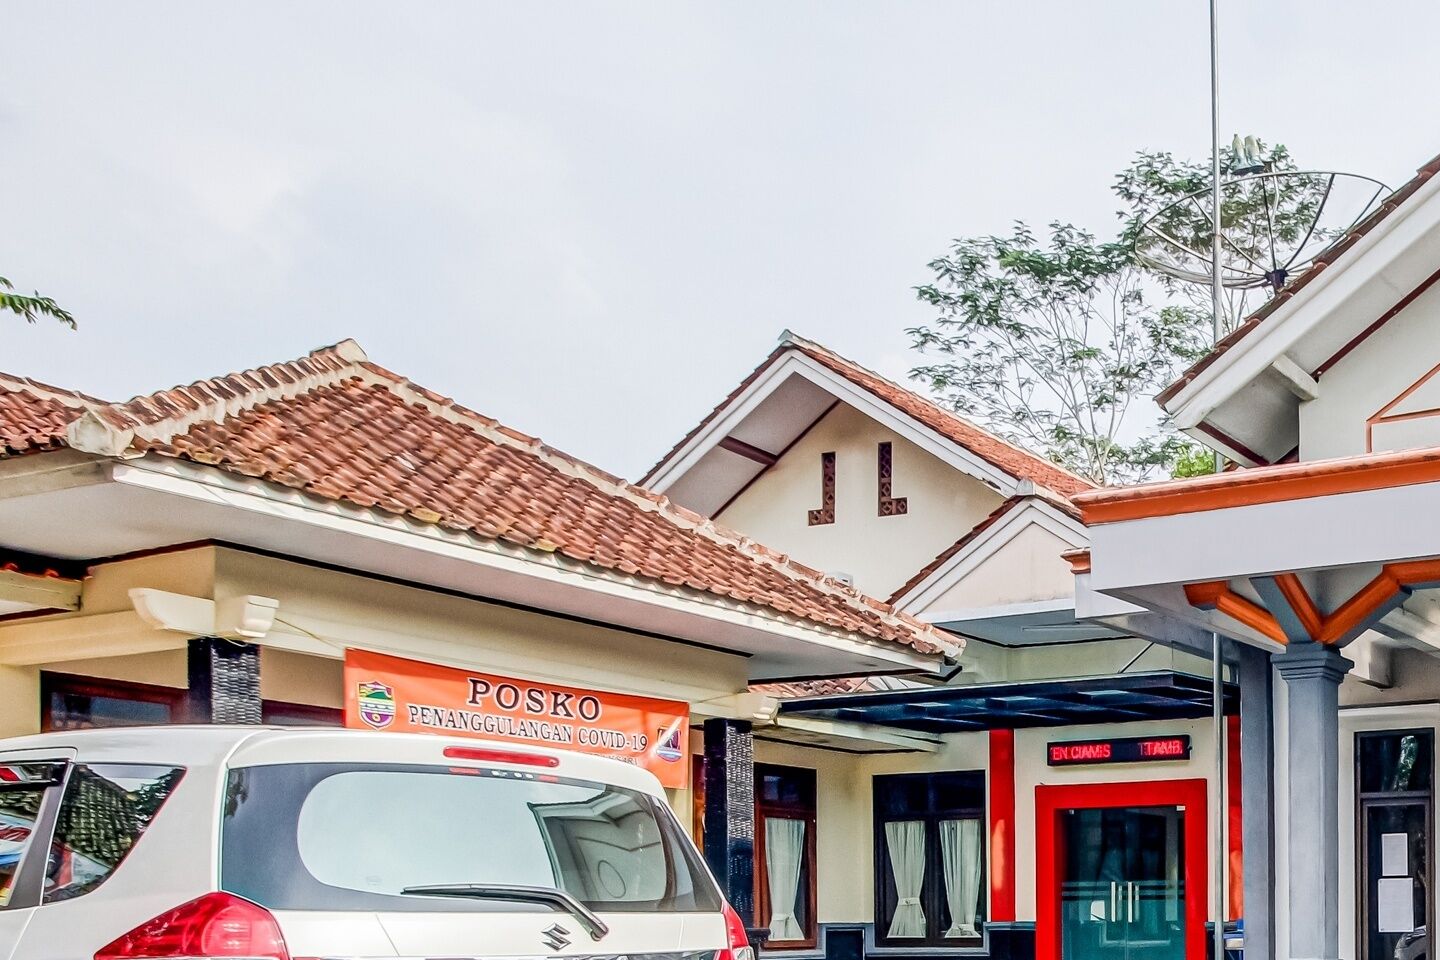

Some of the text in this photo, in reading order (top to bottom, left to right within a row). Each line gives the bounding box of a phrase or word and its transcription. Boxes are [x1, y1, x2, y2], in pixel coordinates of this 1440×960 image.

[469, 678, 601, 721] POSKO
[409, 705, 648, 751] PENANGGULANGAN COVID-19
